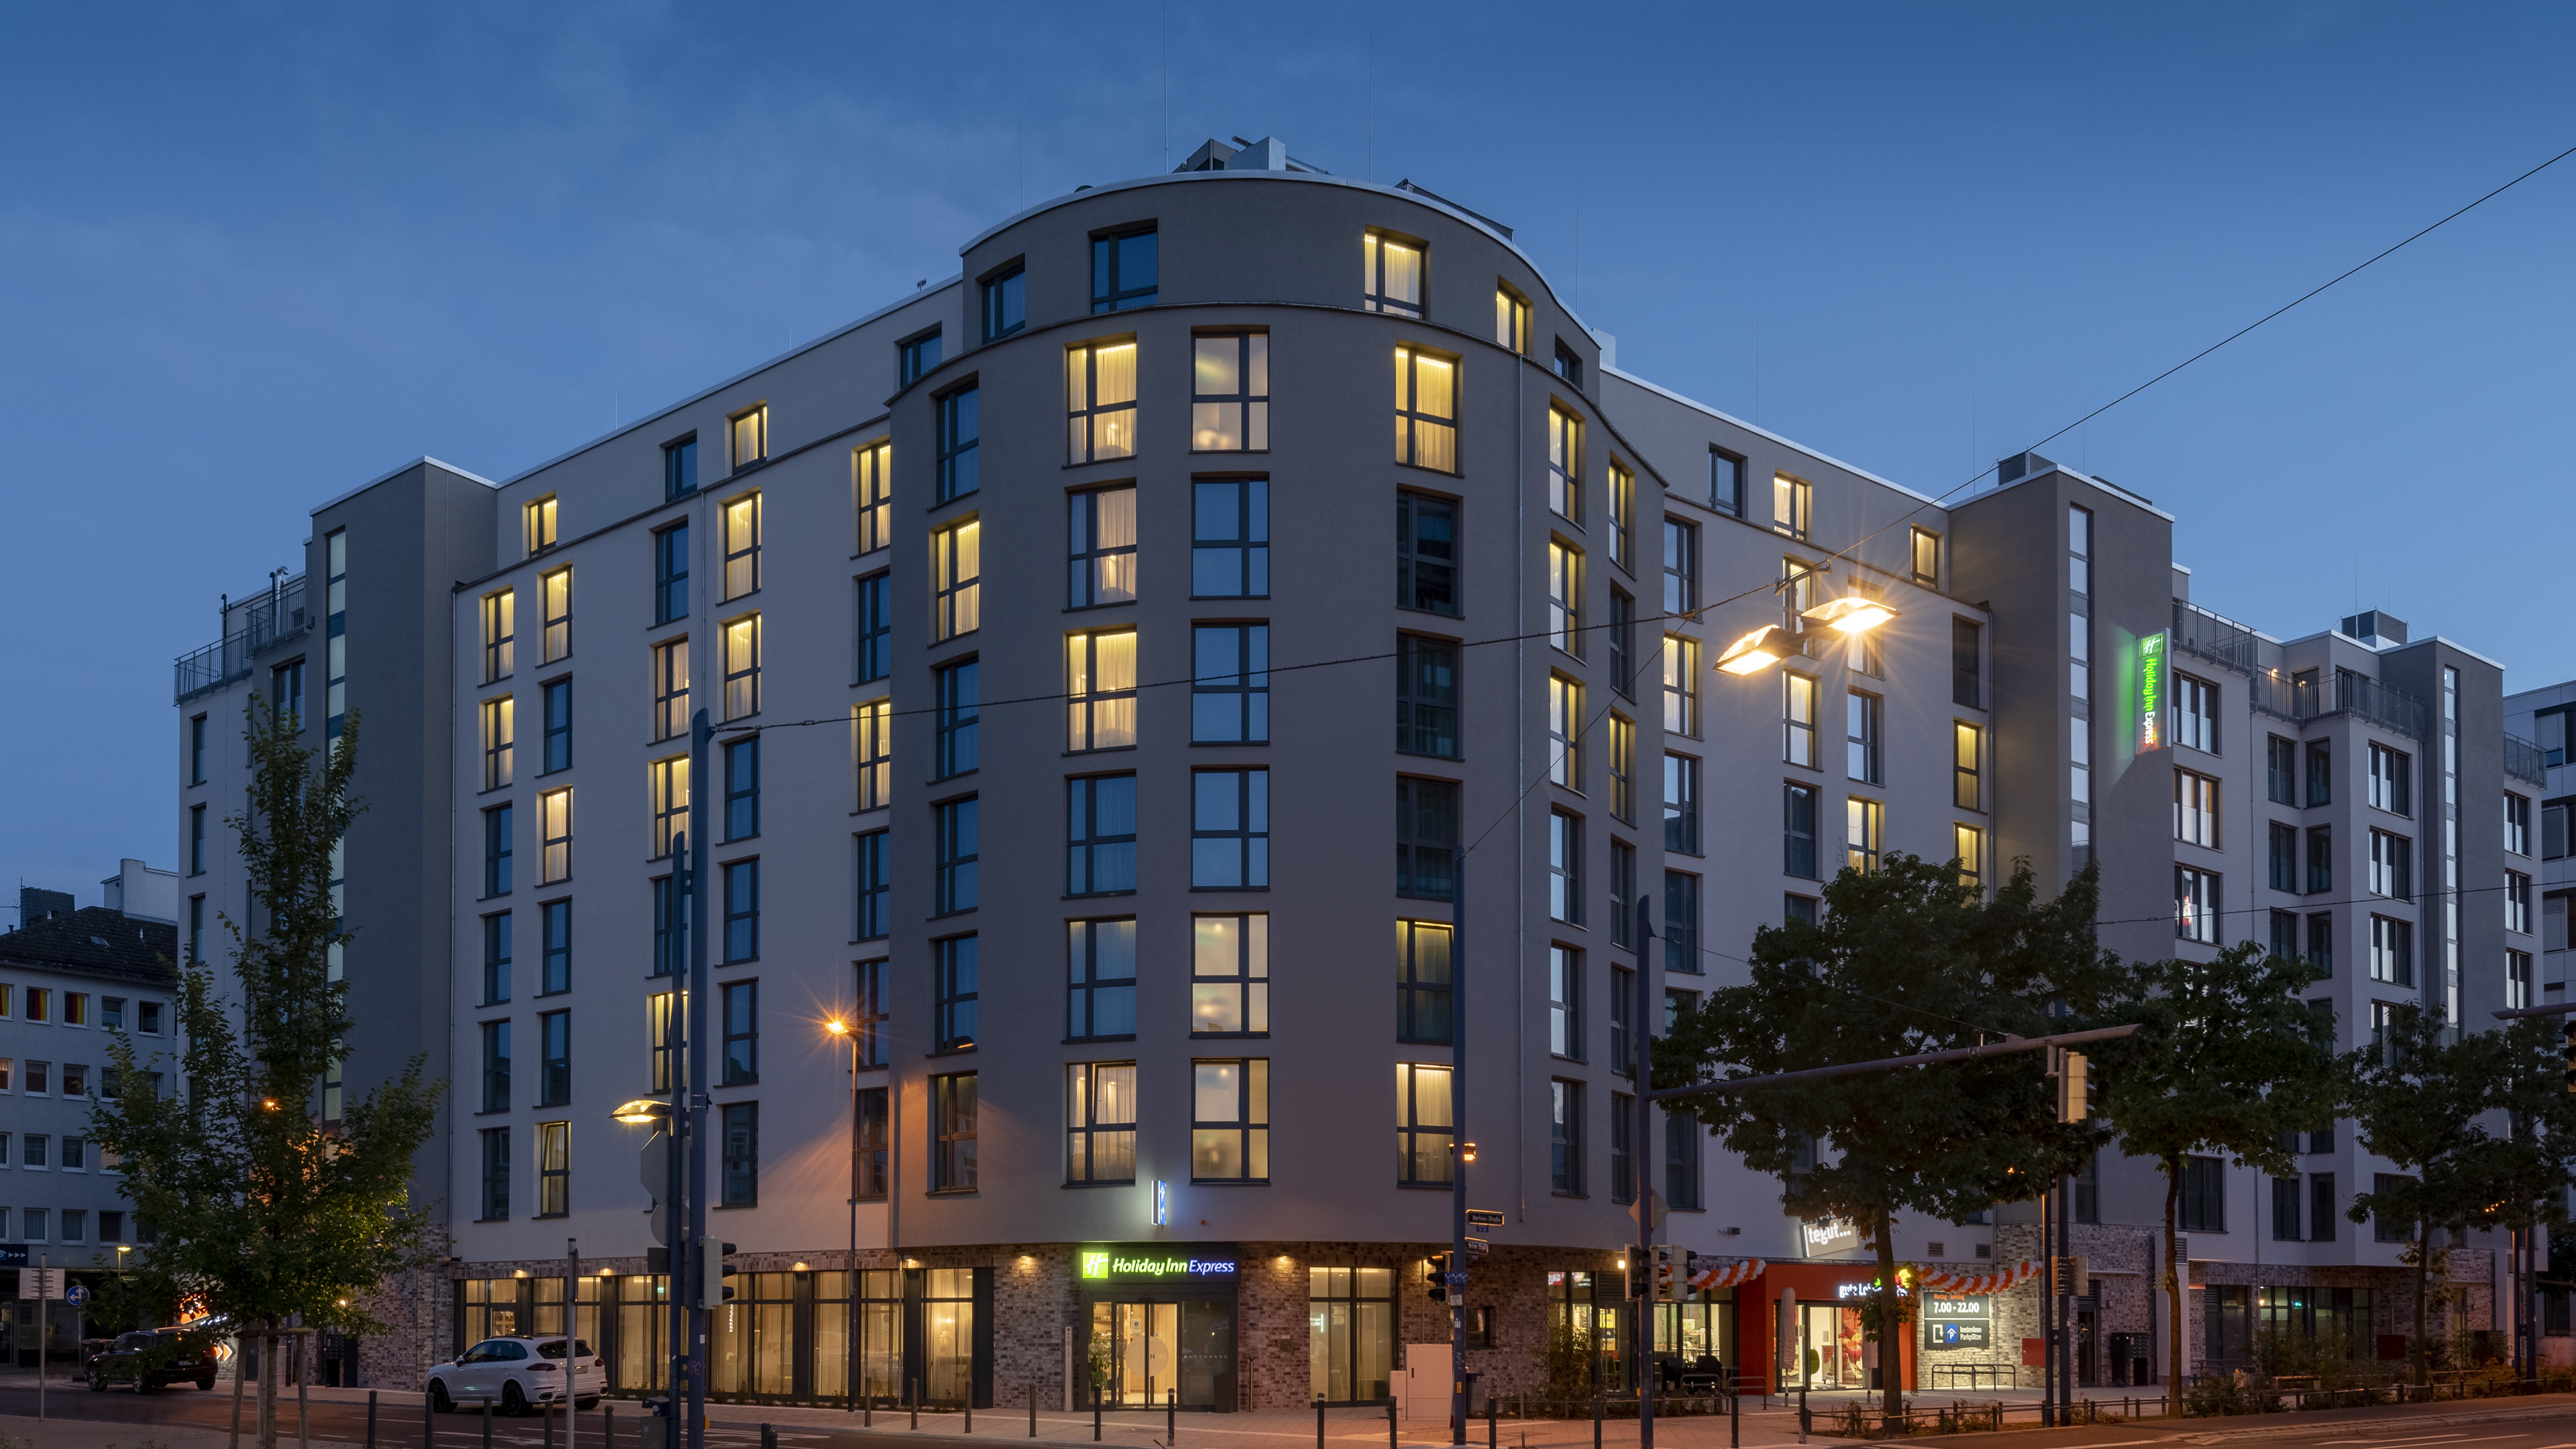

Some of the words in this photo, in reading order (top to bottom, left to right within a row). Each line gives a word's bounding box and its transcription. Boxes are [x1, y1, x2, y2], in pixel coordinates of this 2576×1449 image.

[2143, 657, 2157, 696] Holiday
[2145, 695, 2157, 711] Inn
[2143, 711, 2155, 744] Express
[1112, 1258, 1165, 1275] Holiday
[1165, 1258, 1188, 1273] Inn
[1188, 1260, 1235, 1275] Express
[1933, 1301, 1952, 1313] 7.00
[1957, 1301, 1980, 1313] 22.00
[1960, 1333, 1982, 1342] Parkplätze
